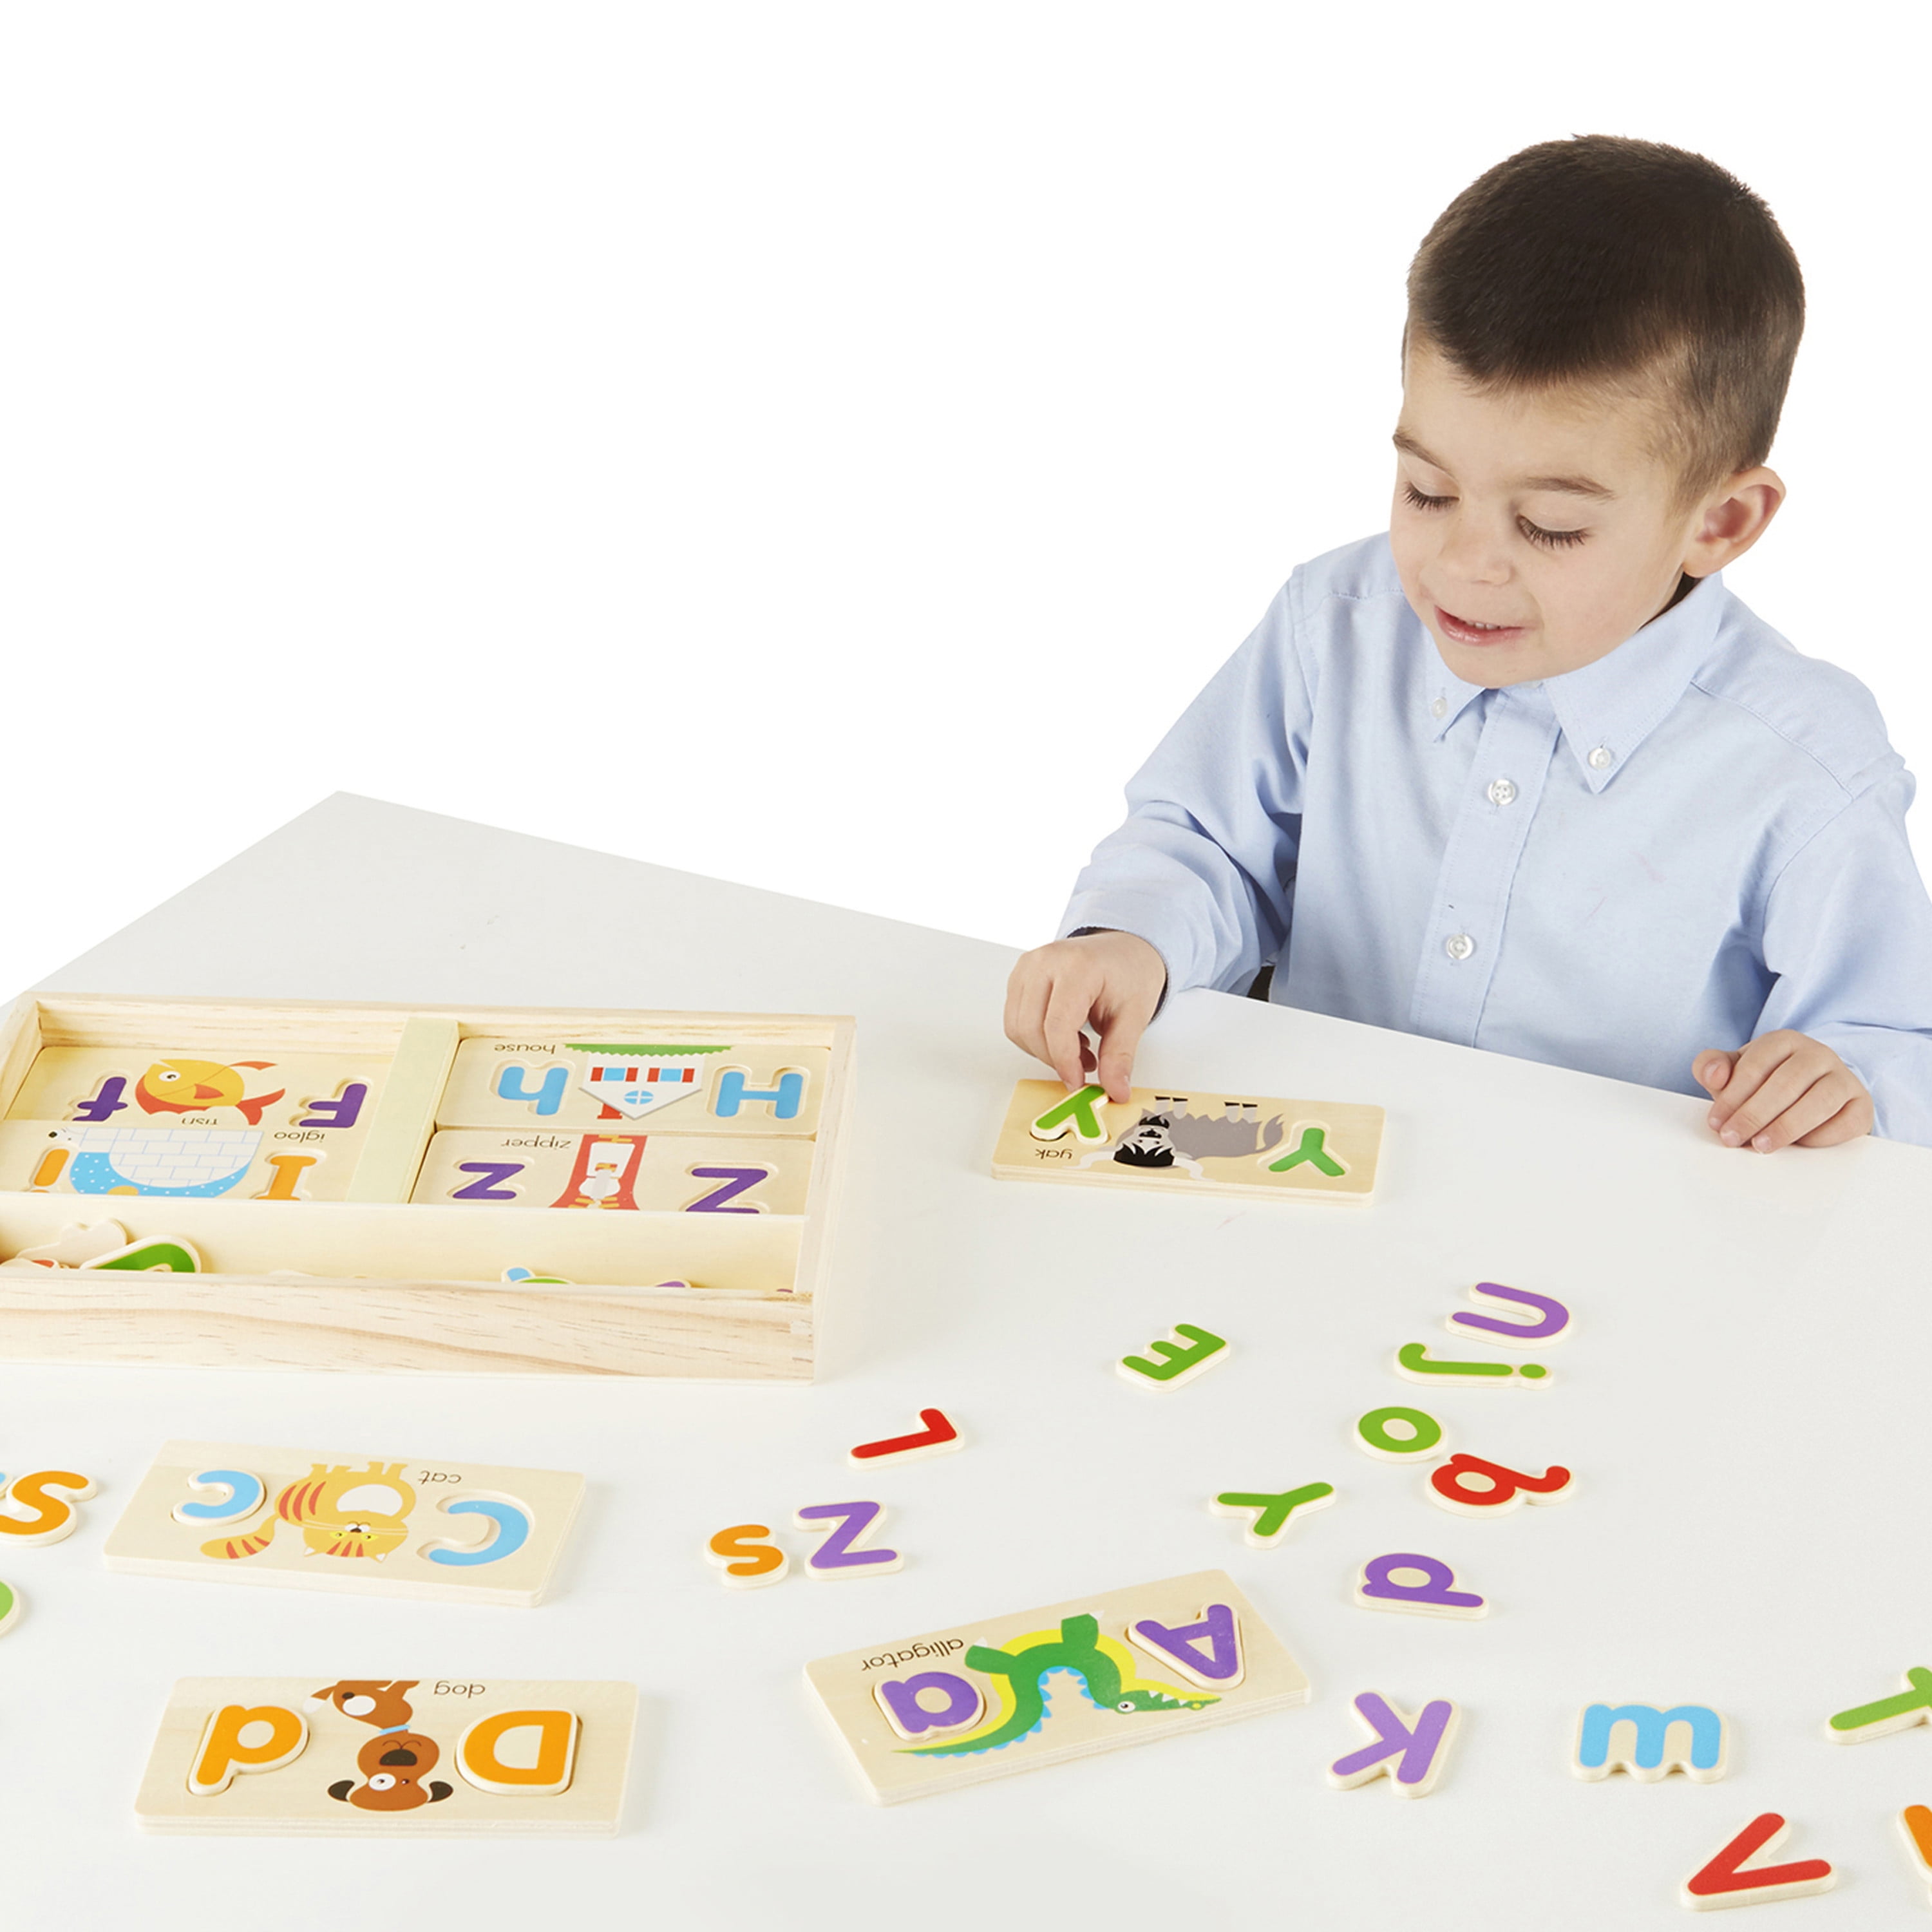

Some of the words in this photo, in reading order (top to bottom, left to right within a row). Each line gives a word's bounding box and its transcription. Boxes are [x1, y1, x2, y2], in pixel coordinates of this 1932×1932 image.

[494, 1043, 556, 1055] house
[299, 1083, 368, 1128] F
[498, 1066, 569, 1115] h
[715, 1071, 803, 1119] H
[274, 1130, 325, 1143] igloo
[500, 1135, 571, 1150] zipper
[1035, 1148, 1074, 1160] yak
[1268, 1127, 1346, 1177] Y
[1121, 1323, 1227, 1381] E
[418, 1470, 462, 1485] cat
[861, 1638, 965, 1672] alligator
[1135, 1604, 1238, 1680] A
[433, 1680, 486, 1699] dog
[463, 1709, 573, 1786] D
